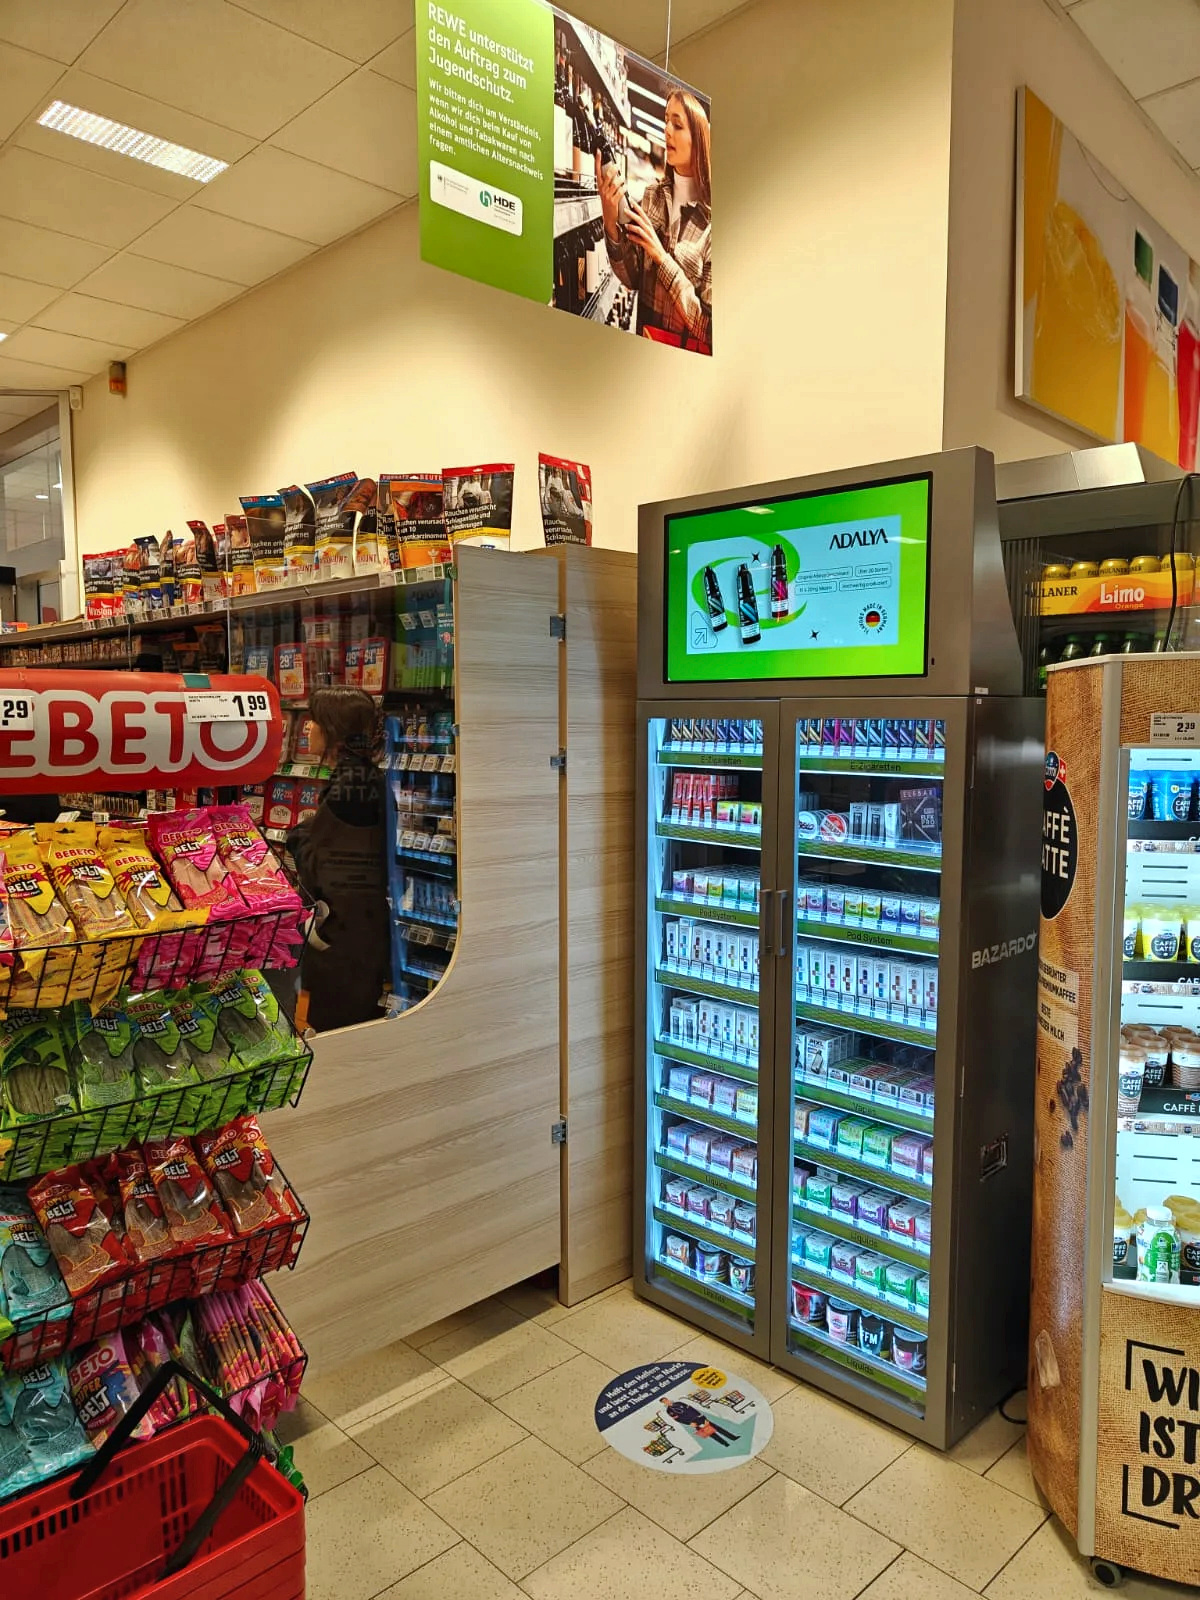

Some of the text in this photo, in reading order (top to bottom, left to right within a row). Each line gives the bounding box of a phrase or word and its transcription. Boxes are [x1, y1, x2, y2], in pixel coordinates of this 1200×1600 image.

[428, 2, 534, 73] REWE unterstützt
[428, 26, 527, 89] den Auftrag zum
[428, 46, 514, 103] Jugendschutz.
[428, 77, 541, 141] Wir bitten dich um Verständnis,
[429, 94, 532, 149] wenn wir dich beim Kauf von
[429, 107, 535, 163] Alkohol und Tabakwaren nach
[429, 134, 456, 156] fragen.
[429, 122, 543, 180] einem amtlichen Altersnachweis
[494, 195, 516, 211] HDE
[829, 528, 889, 551] ADALYA
[1101, 583, 1145, 604] Limo
[232, 695, 267, 717] 1.99
[55, 848, 96, 860] BEBETO
[174, 841, 201, 854] BELT
[67, 858, 93, 868] SUPER
[115, 855, 153, 867] BEBETO
[72, 865, 100, 876] BELT
[131, 871, 157, 882] BELT
[7, 879, 39, 894] BELT
[847, 932, 893, 946] Pod System
[218, 987, 242, 1004] BELT
[93, 1018, 119, 1031] BELT
[140, 1019, 167, 1033] BELT
[179, 1020, 199, 1034] ELT
[1163, 1102, 1196, 1113] CAFFÈ
[214, 1148, 240, 1167] BELT
[163, 1162, 190, 1176] BELT
[133, 1184, 154, 1195] BEL
[46, 1200, 76, 1220] BELT
[9, 1223, 34, 1233] SUPER
[12, 1231, 38, 1242] BELT
[851, 1234, 878, 1248] Liquids
[22, 1364, 51, 1384] BELT
[624, 1377, 637, 1390] den
[1142, 1359, 1200, 1412] WI
[80, 1386, 111, 1423] BELT
[599, 1404, 613, 1414] und
[1140, 1410, 1200, 1465] IST
[1142, 1465, 1200, 1520] DR
